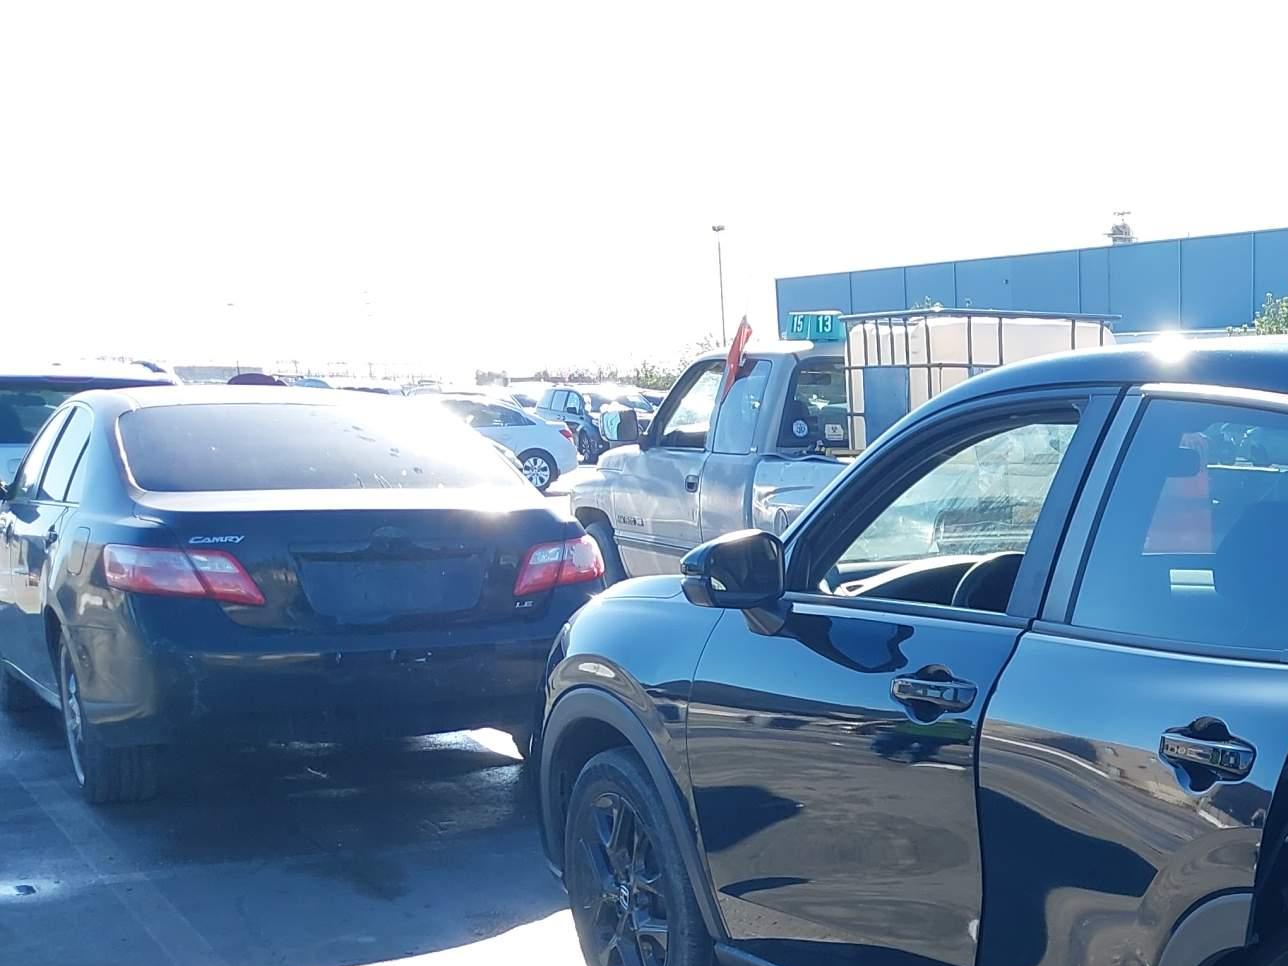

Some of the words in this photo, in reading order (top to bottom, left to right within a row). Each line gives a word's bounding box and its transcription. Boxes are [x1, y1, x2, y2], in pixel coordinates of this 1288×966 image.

[793, 314, 804, 333] 15
[817, 314, 832, 333] 13
[189, 535, 245, 544] CAMRY
